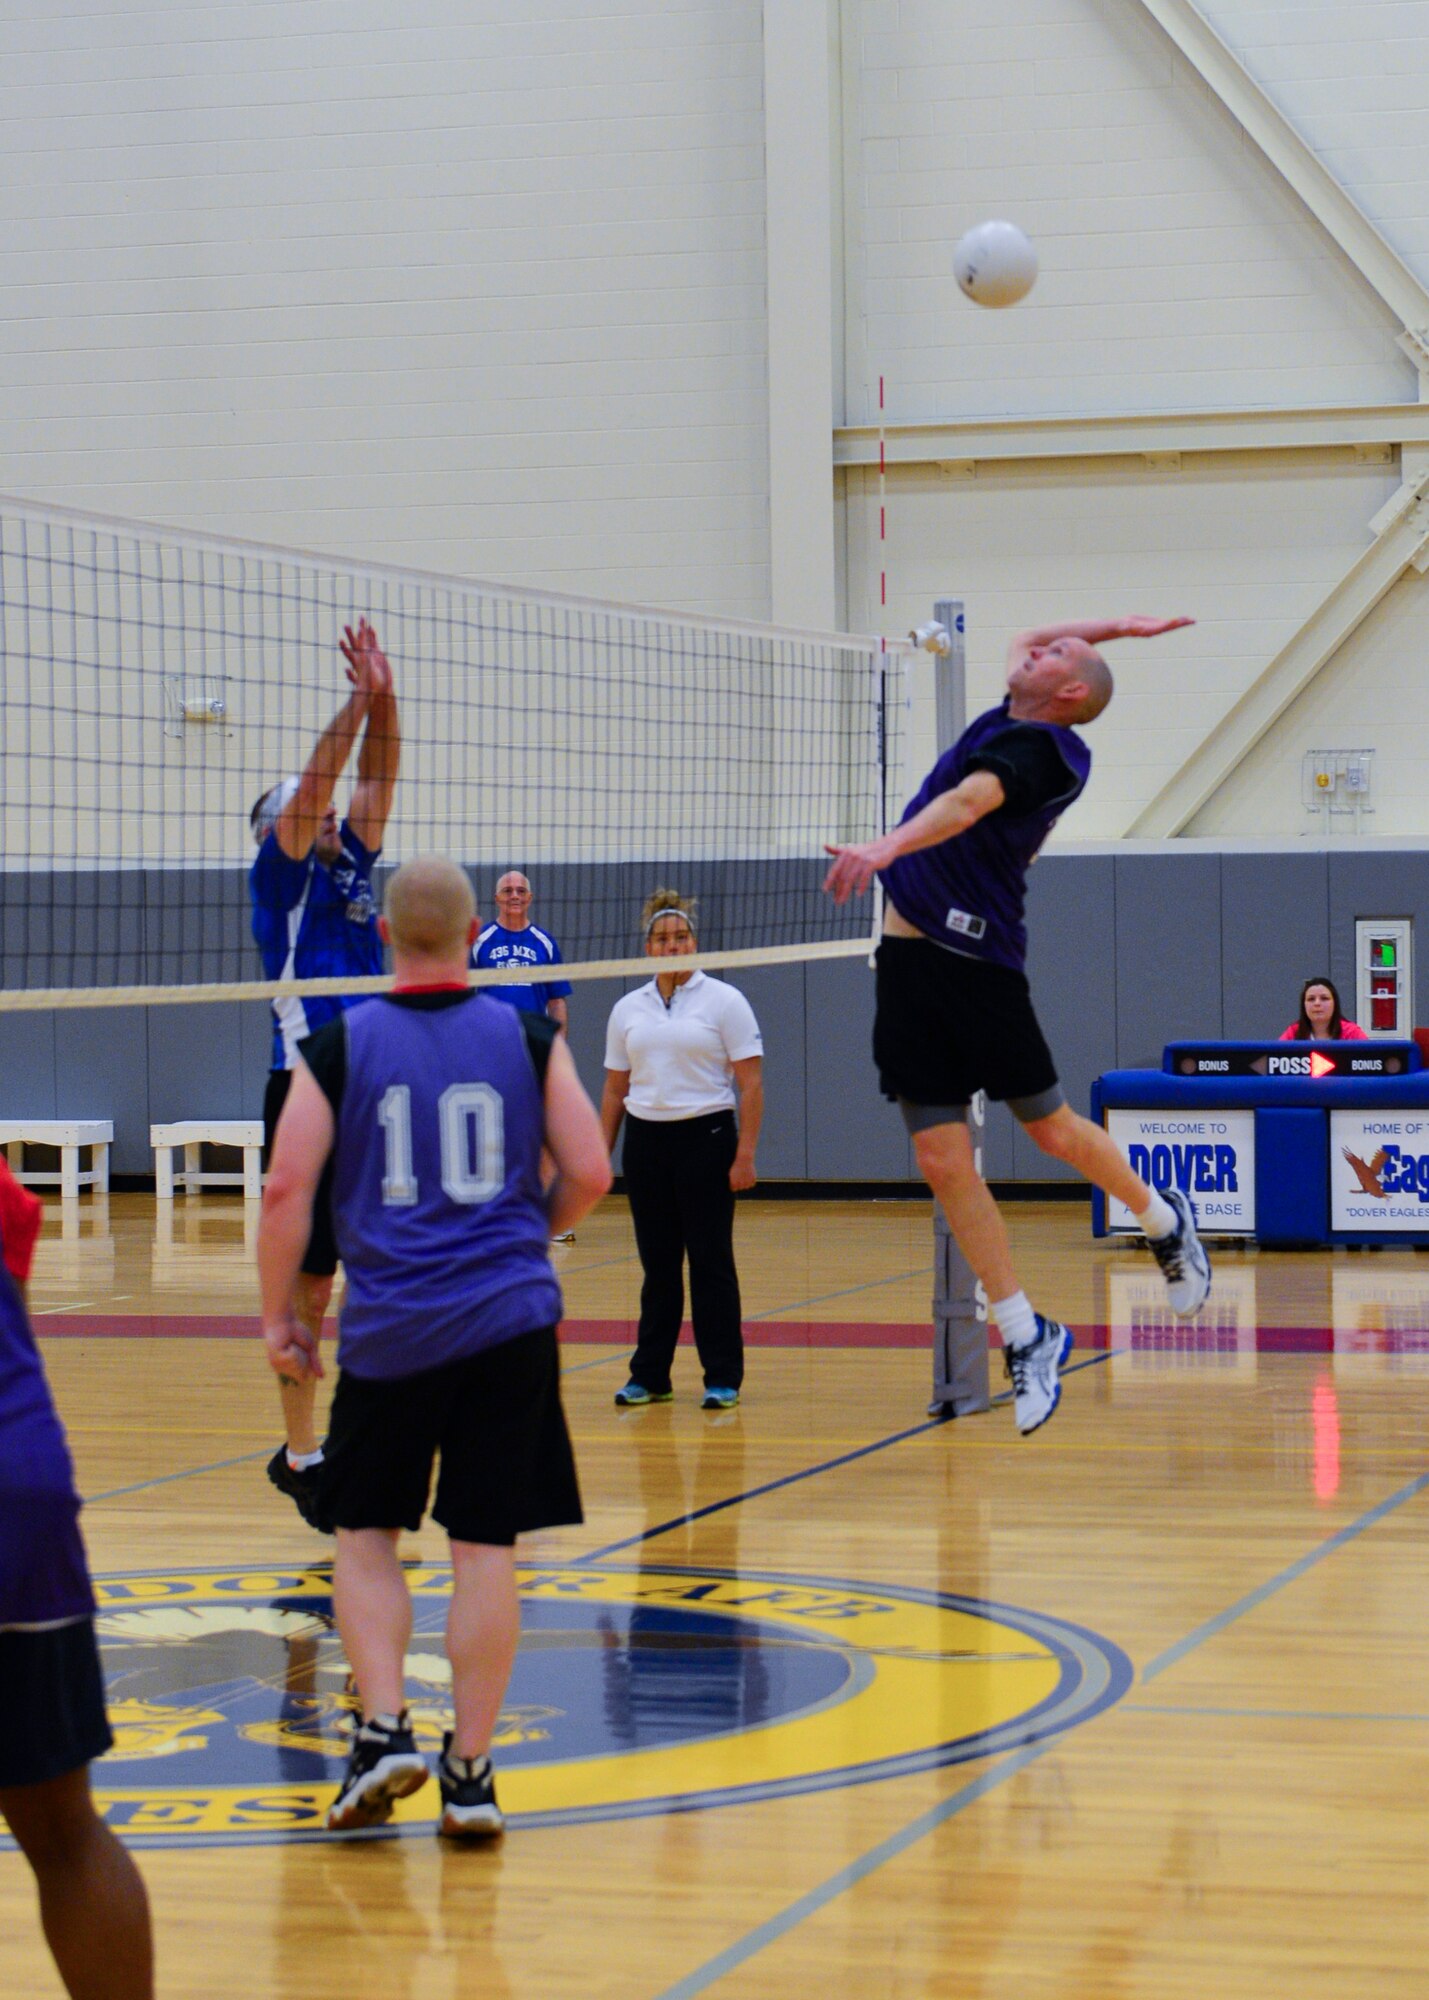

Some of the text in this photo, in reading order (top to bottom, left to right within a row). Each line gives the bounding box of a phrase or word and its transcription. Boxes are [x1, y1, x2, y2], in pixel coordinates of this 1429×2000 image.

[512, 944, 537, 961] MXS
[1198, 1060, 1230, 1072] BONUS
[1268, 1056, 1312, 1075] POSS
[1351, 1060, 1383, 1071] BONUS
[1140, 1123, 1228, 1134] WELCOME TO
[1363, 1123, 1424, 1134] HOME OF
[377, 1082, 505, 1206] 10
[1128, 1143, 1239, 1193] DOVER
[1204, 1203, 1243, 1216] BASE
[97, 1573, 607, 1598] DOR
